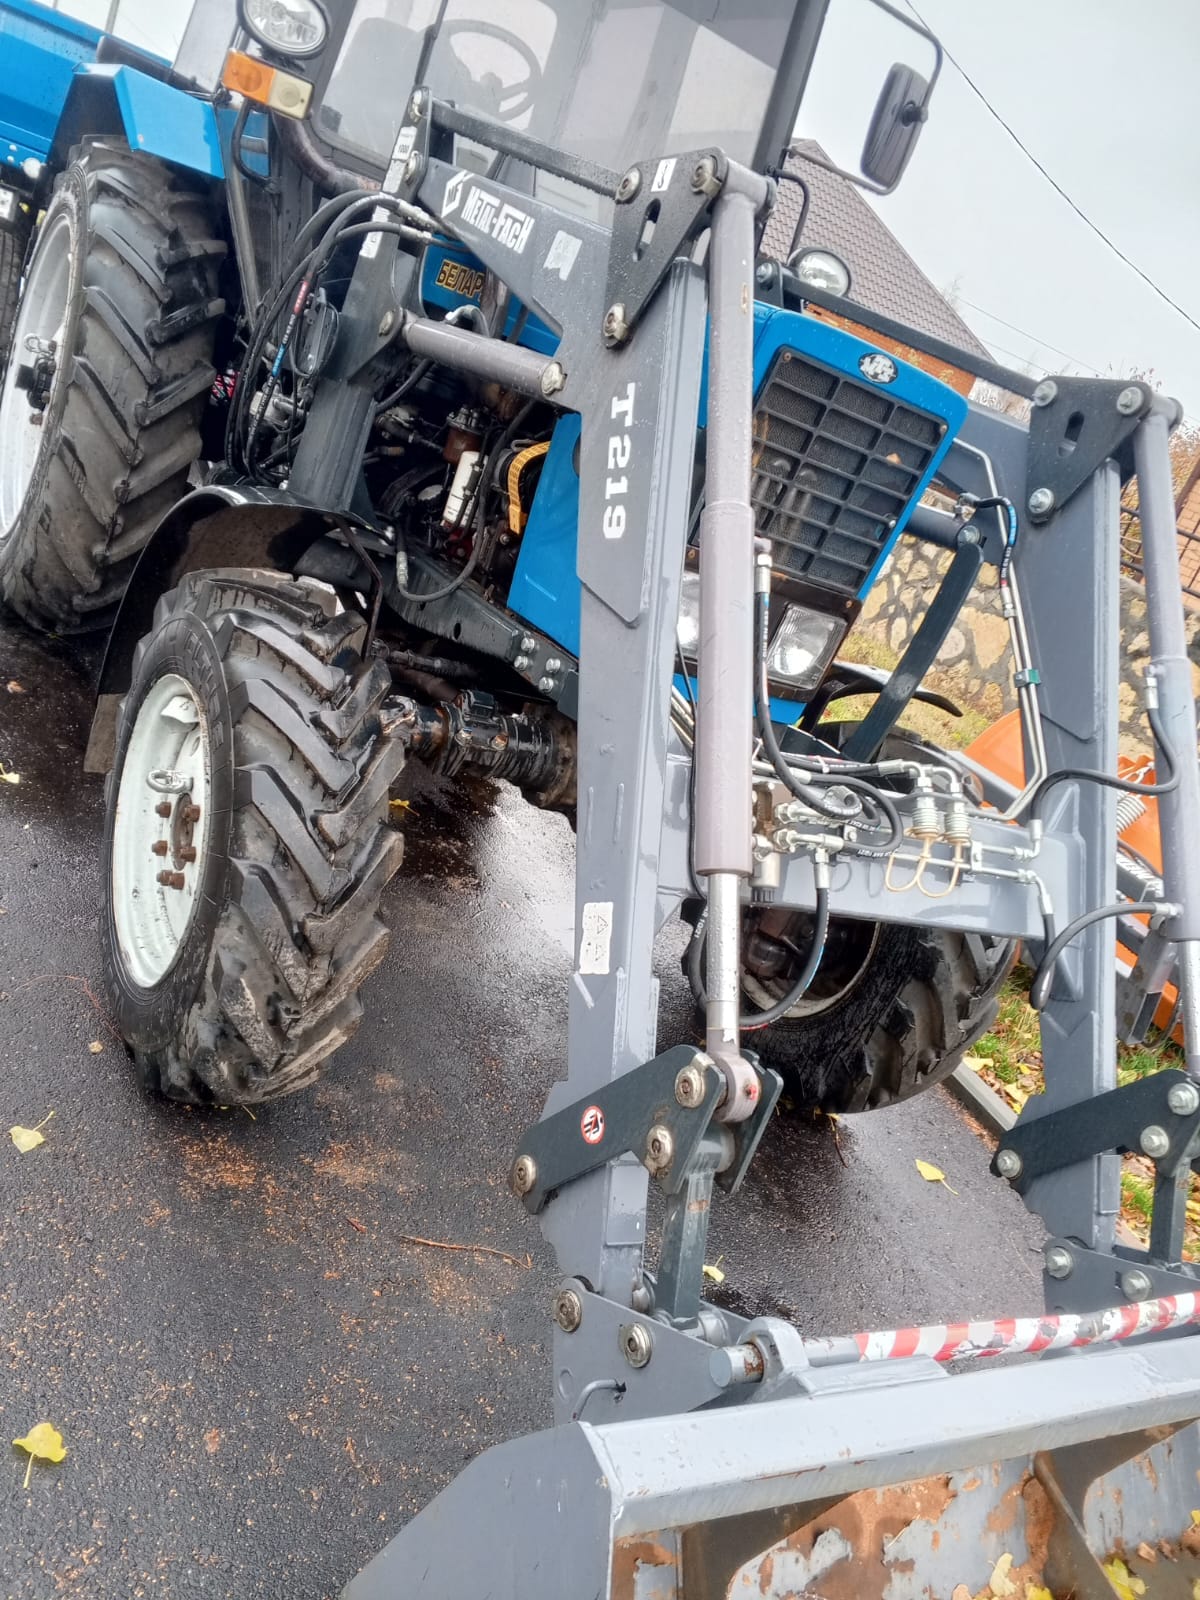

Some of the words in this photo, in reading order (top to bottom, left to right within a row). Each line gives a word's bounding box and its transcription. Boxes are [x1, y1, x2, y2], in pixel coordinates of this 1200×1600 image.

[460, 186, 536, 255] METAL-FACH
[435, 258, 485, 303] БЕЛАР
[602, 382, 636, 539] T219
